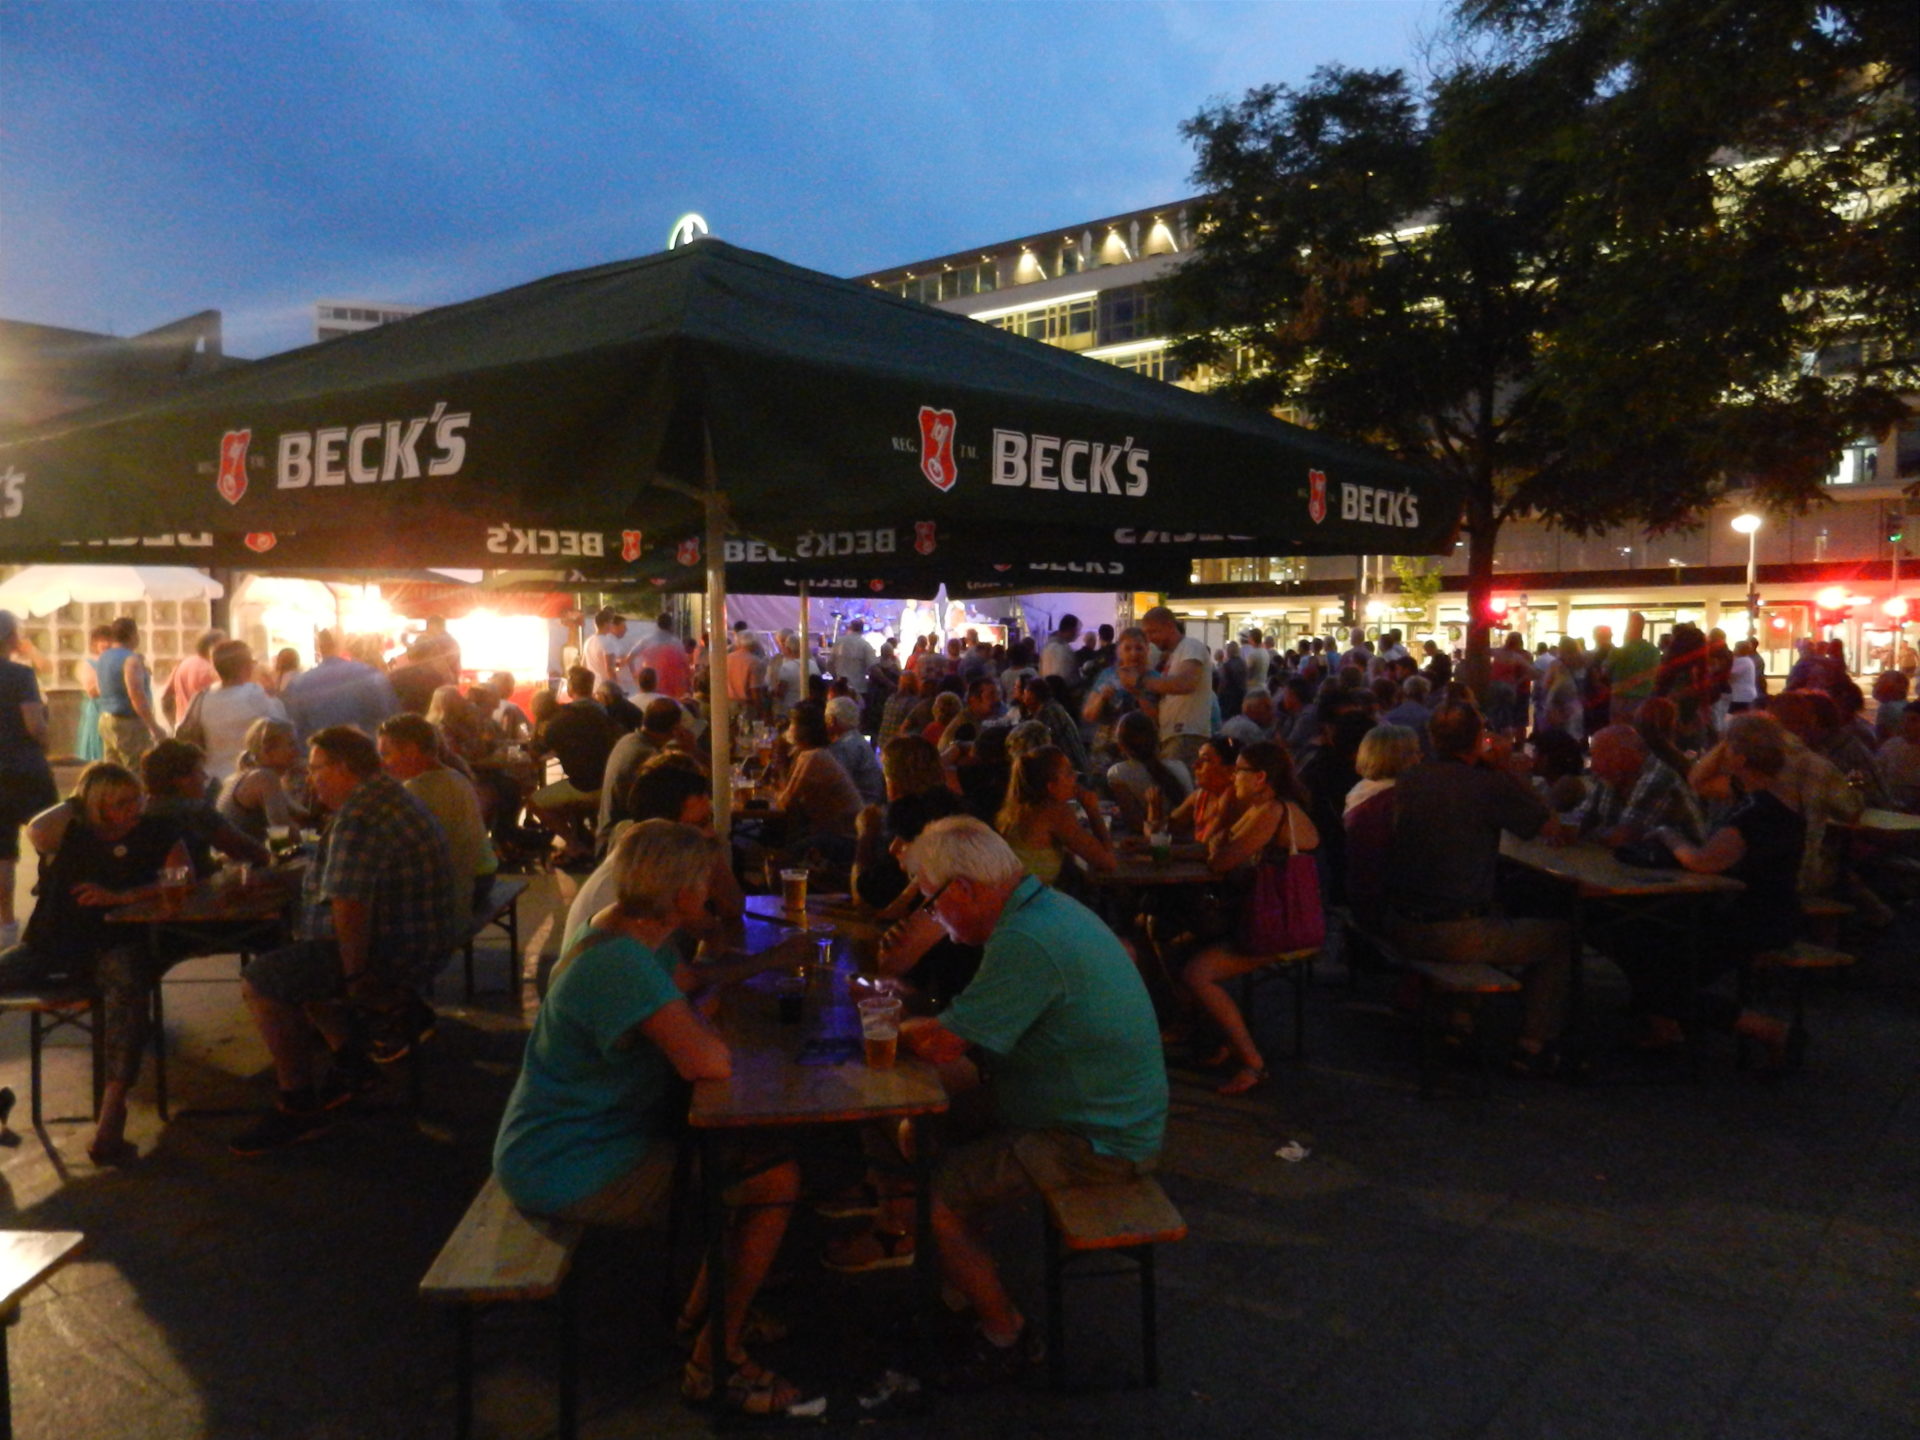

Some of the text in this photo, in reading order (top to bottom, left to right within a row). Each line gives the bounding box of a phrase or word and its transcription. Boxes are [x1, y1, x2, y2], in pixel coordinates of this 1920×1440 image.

[277, 401, 471, 490] BECK'S
[991, 427, 1150, 498] BECK'S
[1340, 481, 1420, 529] BECK'S
